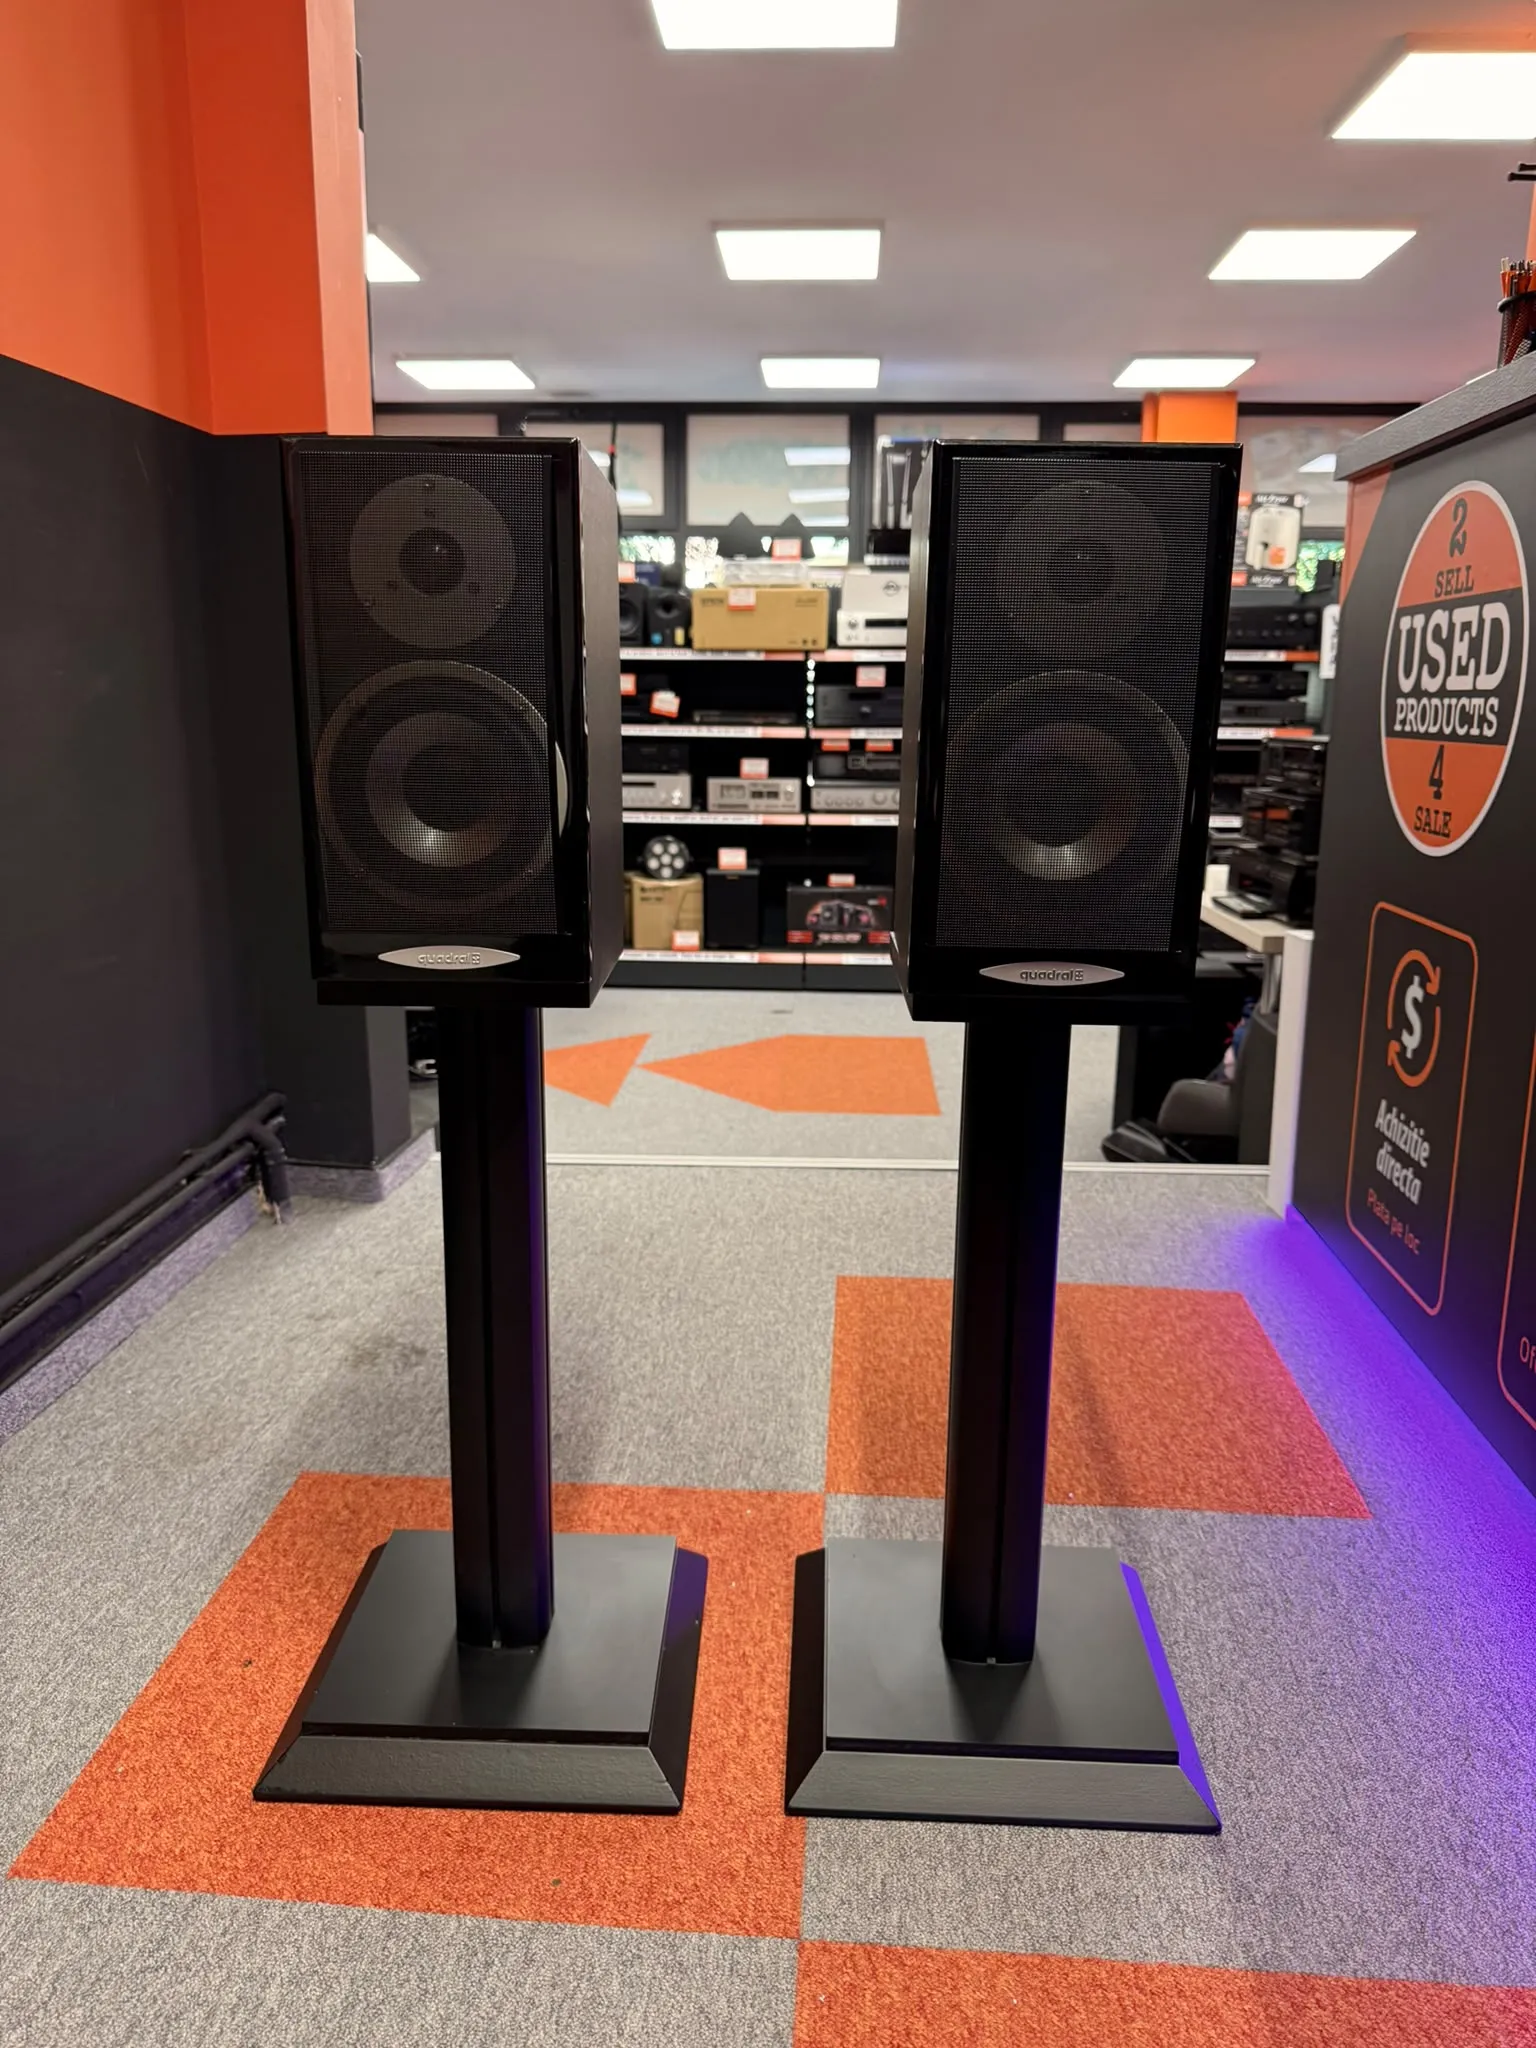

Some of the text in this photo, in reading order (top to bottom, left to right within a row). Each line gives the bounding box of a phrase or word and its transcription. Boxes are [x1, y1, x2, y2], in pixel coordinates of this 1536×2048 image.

[1449, 498, 1468, 558] 2
[1434, 564, 1475, 599] SELL
[1398, 602, 1511, 694] USED
[1393, 697, 1499, 737] PRODUCTS
[1428, 744, 1445, 801] 4
[1413, 806, 1452, 839] SALE
[417, 952, 470, 966] quadral
[1019, 968, 1074, 982] quadral
[1374, 1098, 1431, 1169] Achizitie
[1376, 1140, 1422, 1205] directa
[1520, 1336, 1536, 1374] Of
